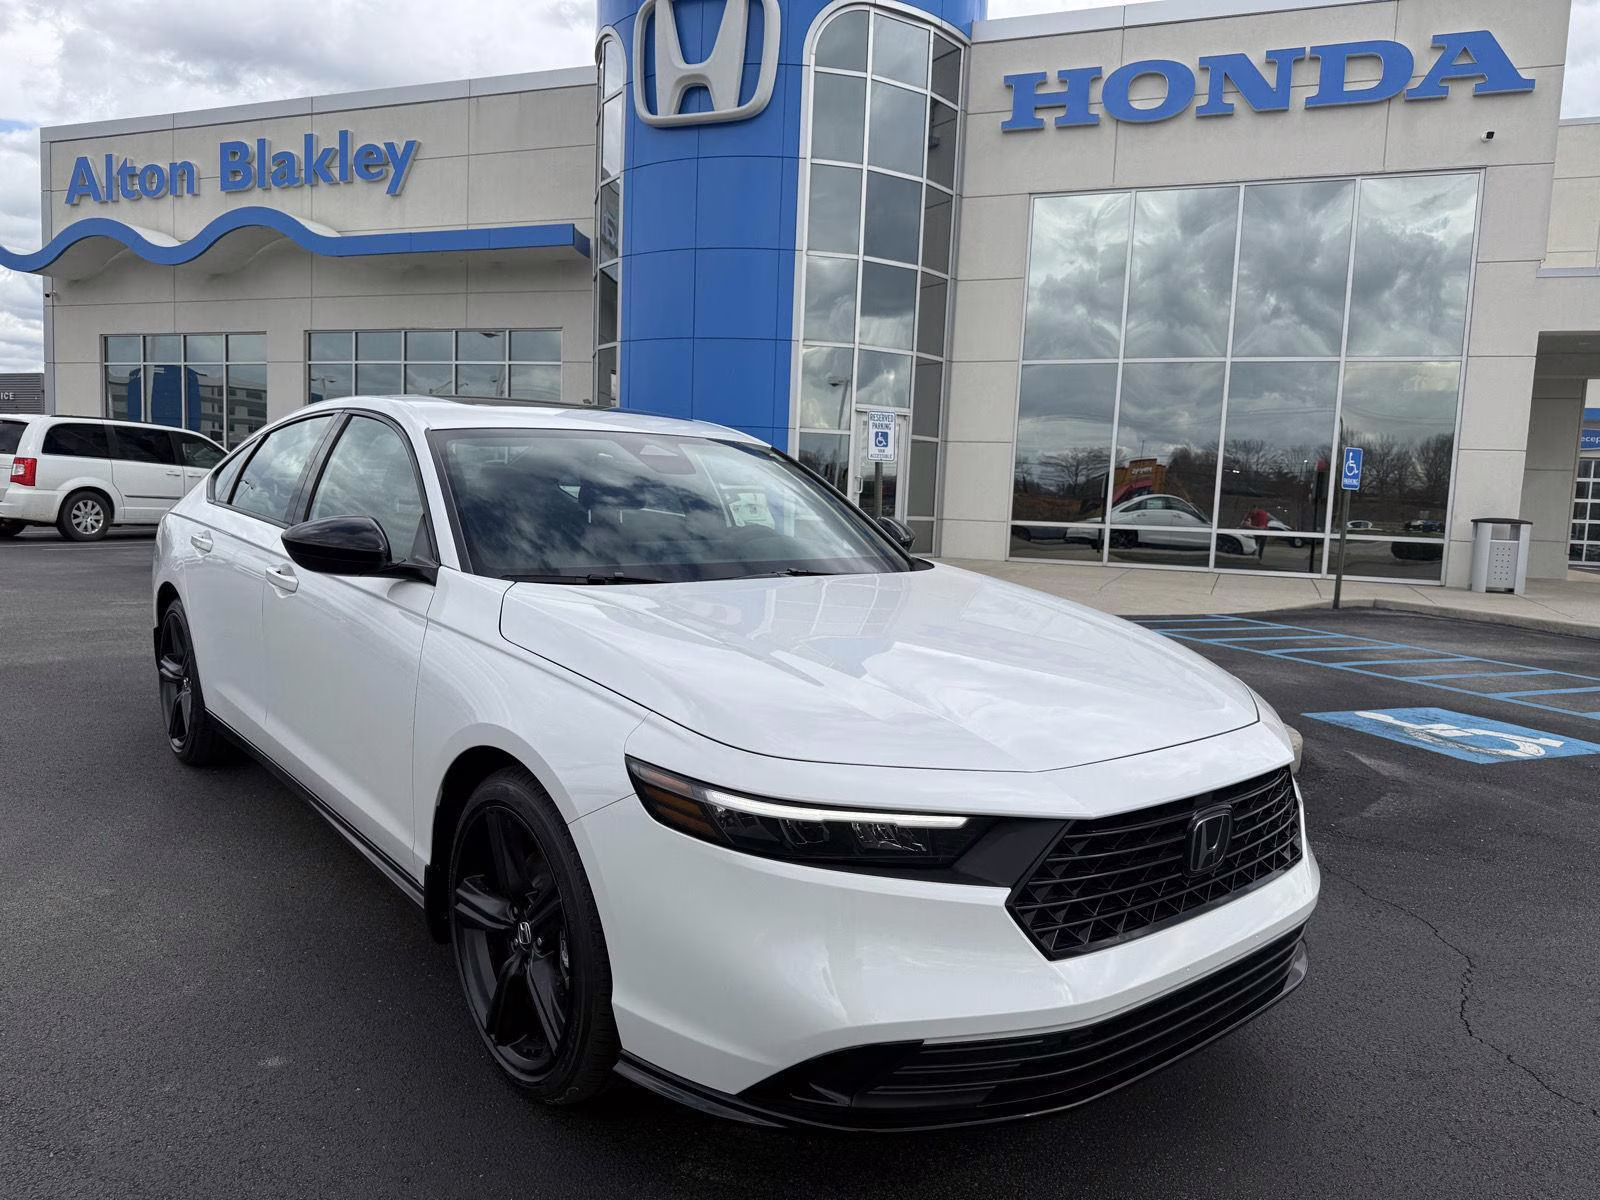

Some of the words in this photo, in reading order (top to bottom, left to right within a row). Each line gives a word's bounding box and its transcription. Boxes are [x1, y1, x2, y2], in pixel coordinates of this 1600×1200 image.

[1001, 29, 1536, 132] HONDA
[65, 153, 200, 206] Alton
[219, 129, 422, 199] Blakley
[869, 413, 894, 422] RESERVED
[871, 422, 892, 430] PARKING
